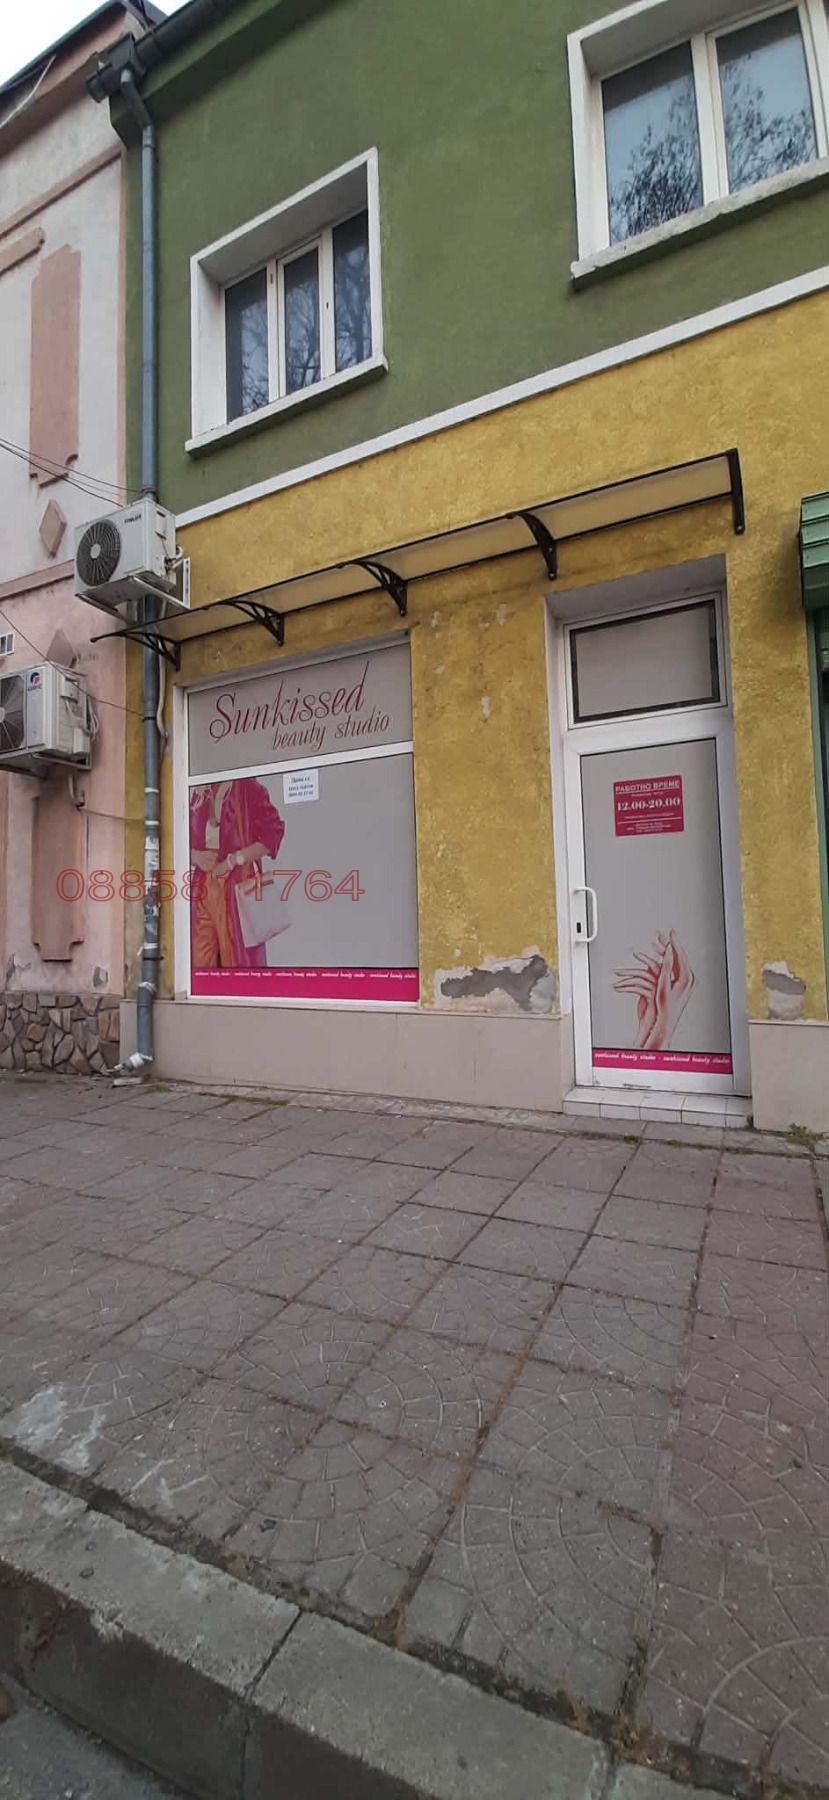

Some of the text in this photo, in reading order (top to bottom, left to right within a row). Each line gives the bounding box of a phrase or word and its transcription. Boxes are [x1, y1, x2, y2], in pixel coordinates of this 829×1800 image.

[209, 660, 369, 743] Sunkissed
[272, 705, 390, 751] beauty studio
[615, 780, 680, 793] РАБОТНО ВРЕМЕ
[617, 797, 681, 811] 12.00-20.00
